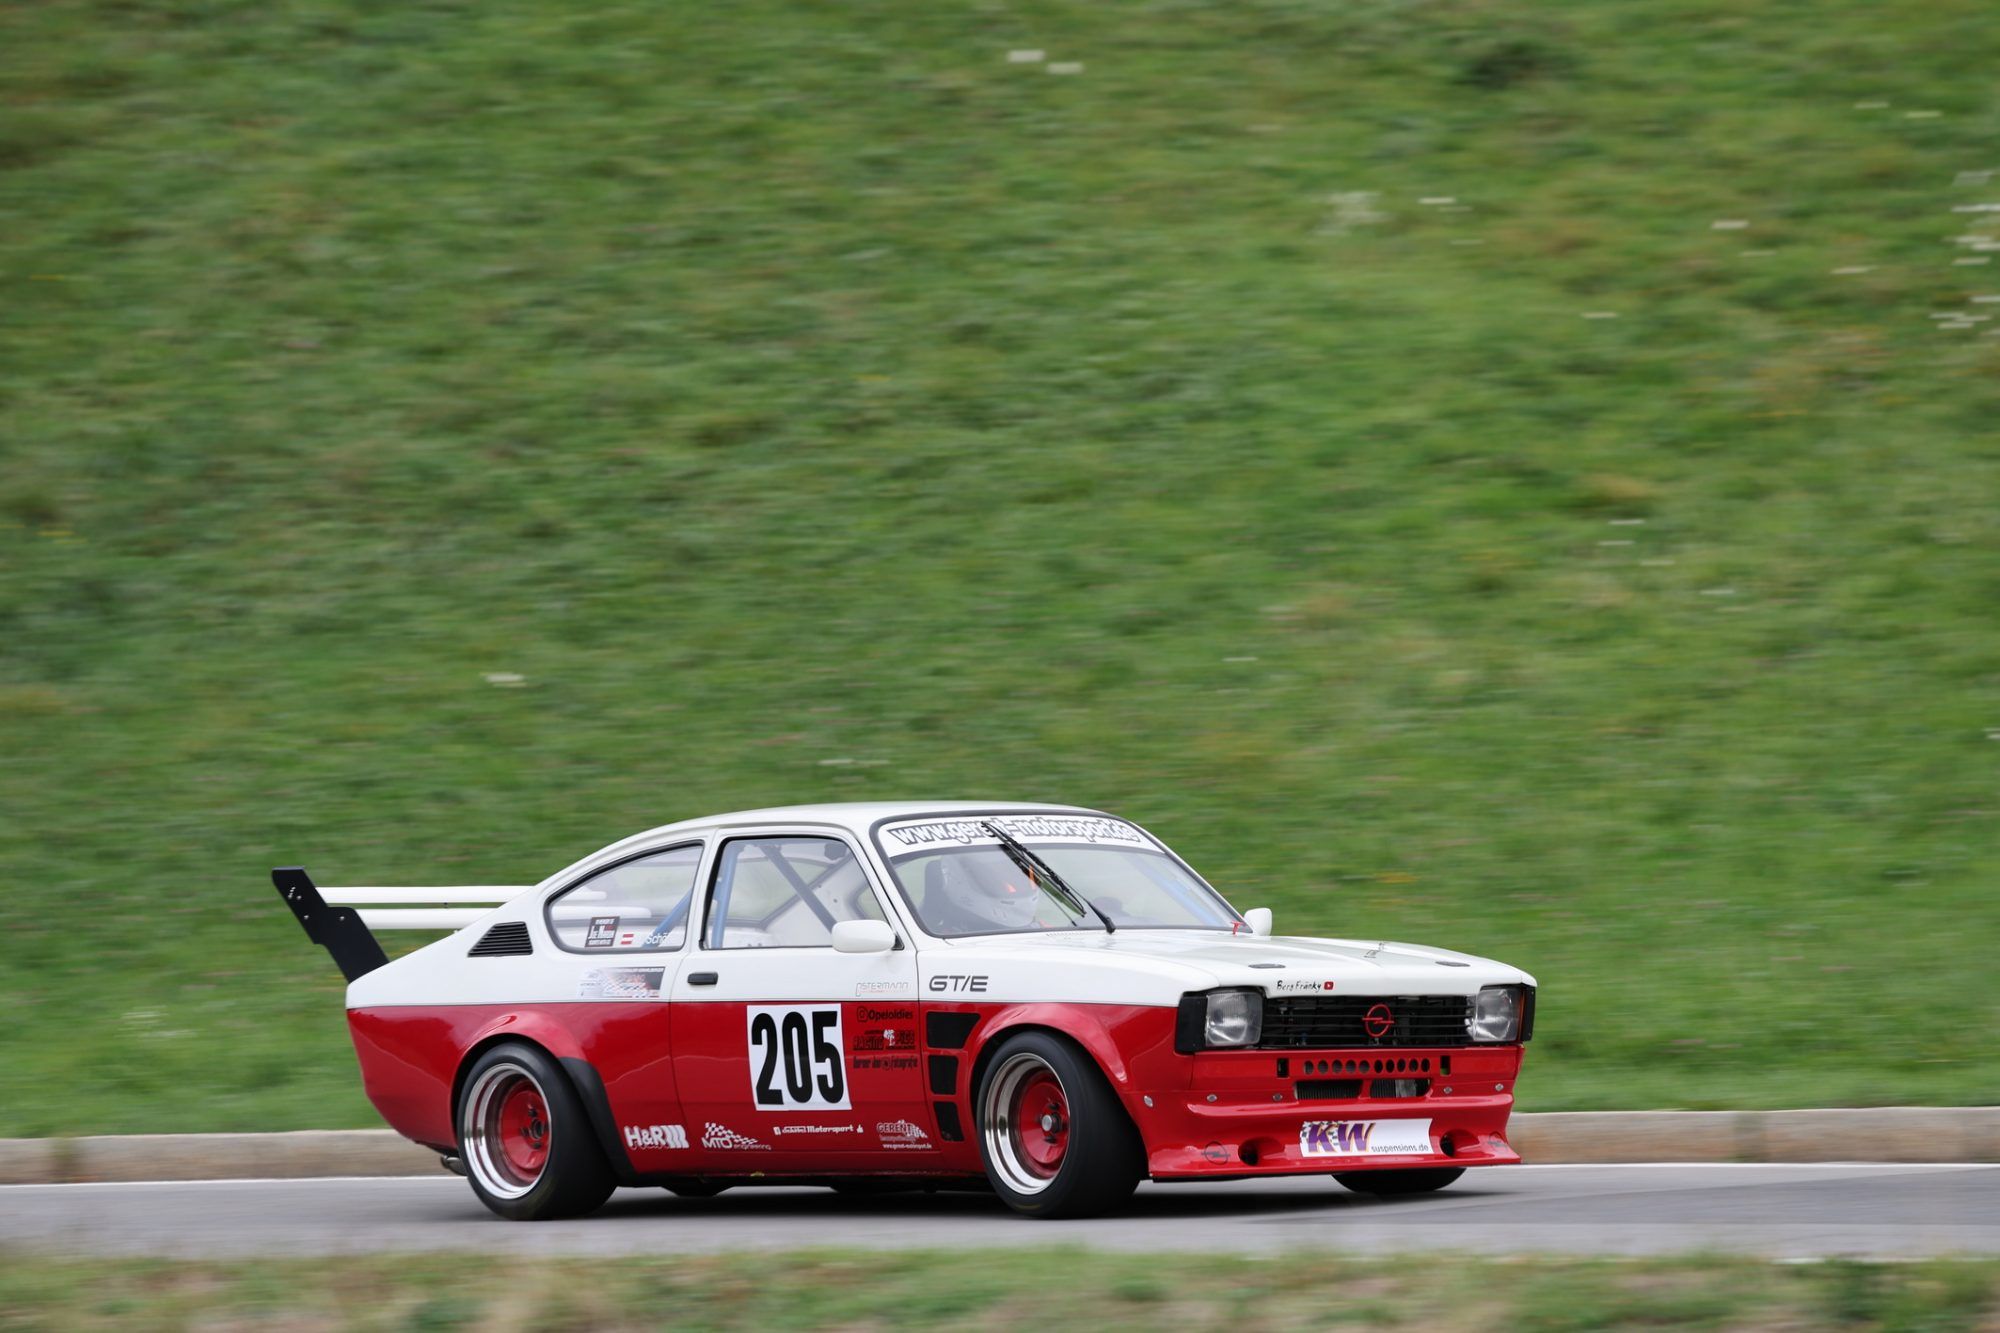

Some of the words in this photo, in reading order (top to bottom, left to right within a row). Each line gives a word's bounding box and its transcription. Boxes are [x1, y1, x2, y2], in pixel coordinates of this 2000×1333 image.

[929, 976, 989, 992] GT/E
[751, 1011, 844, 1105] 205
[624, 1125, 667, 1147] H&R
[701, 1136, 732, 1149] MTO
[1308, 1122, 1376, 1153] KW
[1371, 1143, 1430, 1153] suspensions.de
